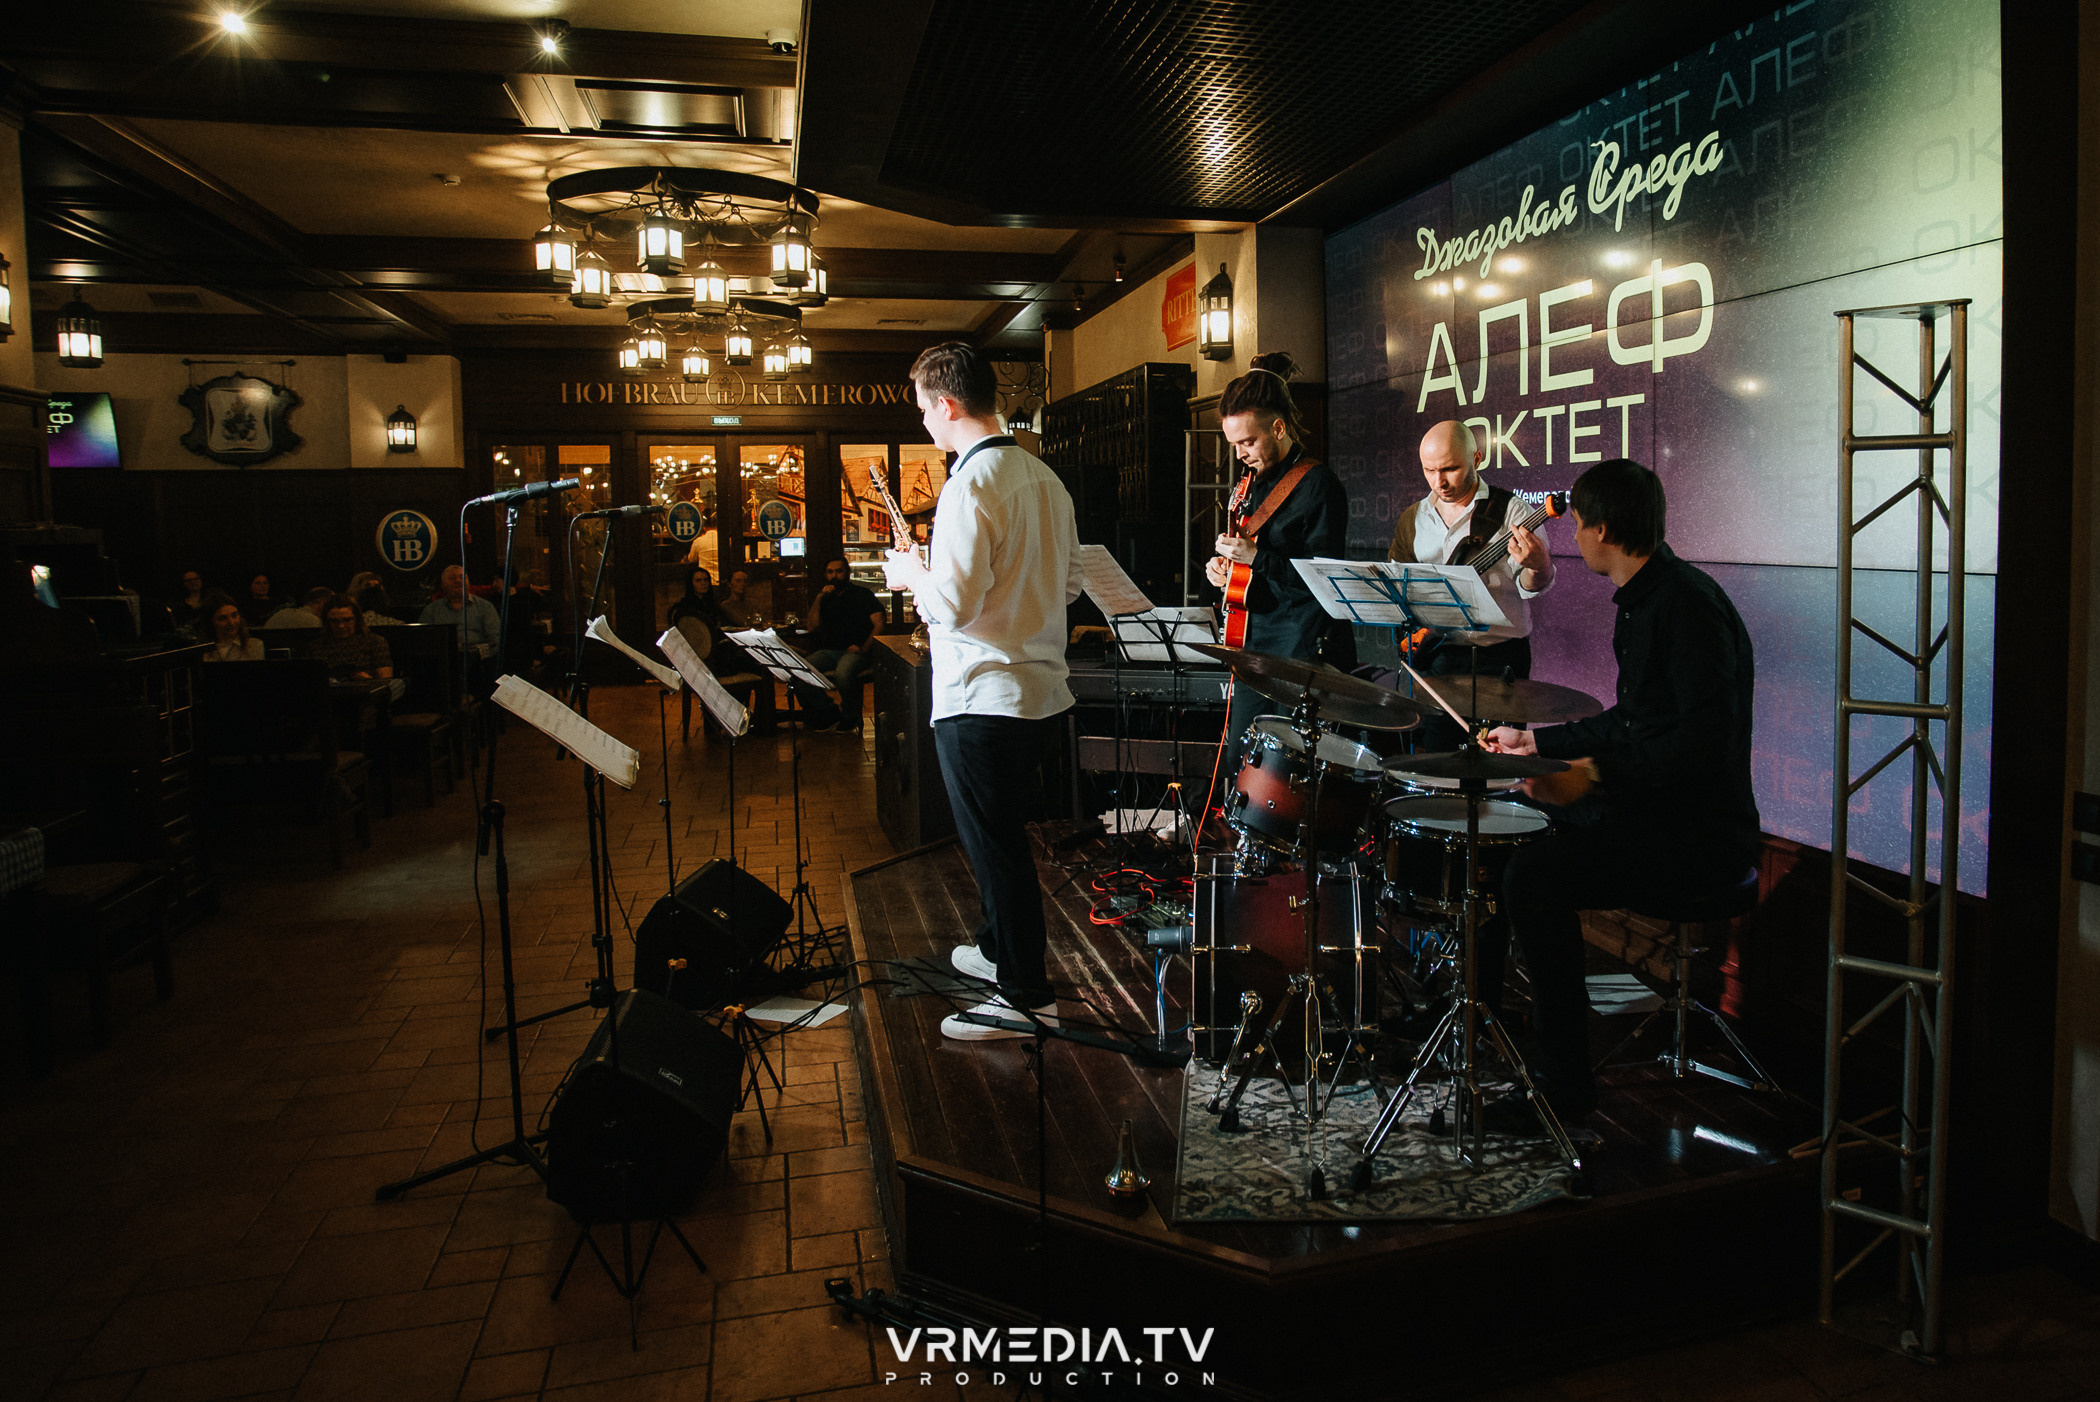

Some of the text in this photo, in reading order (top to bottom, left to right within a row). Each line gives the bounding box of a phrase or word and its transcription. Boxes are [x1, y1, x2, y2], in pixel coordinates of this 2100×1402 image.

[1710, 12, 1875, 121] АЛЕФ
[1414, 184, 1577, 280] Джазовая
[1587, 130, 1724, 232] Среда
[1416, 258, 1714, 414] АЛЕФ
[561, 377, 698, 404] HOFBRÄU
[1463, 393, 1645, 471] ОКТЕТ
[392, 538, 424, 562] HB
[674, 520, 696, 536] HB
[766, 519, 787, 536] HB
